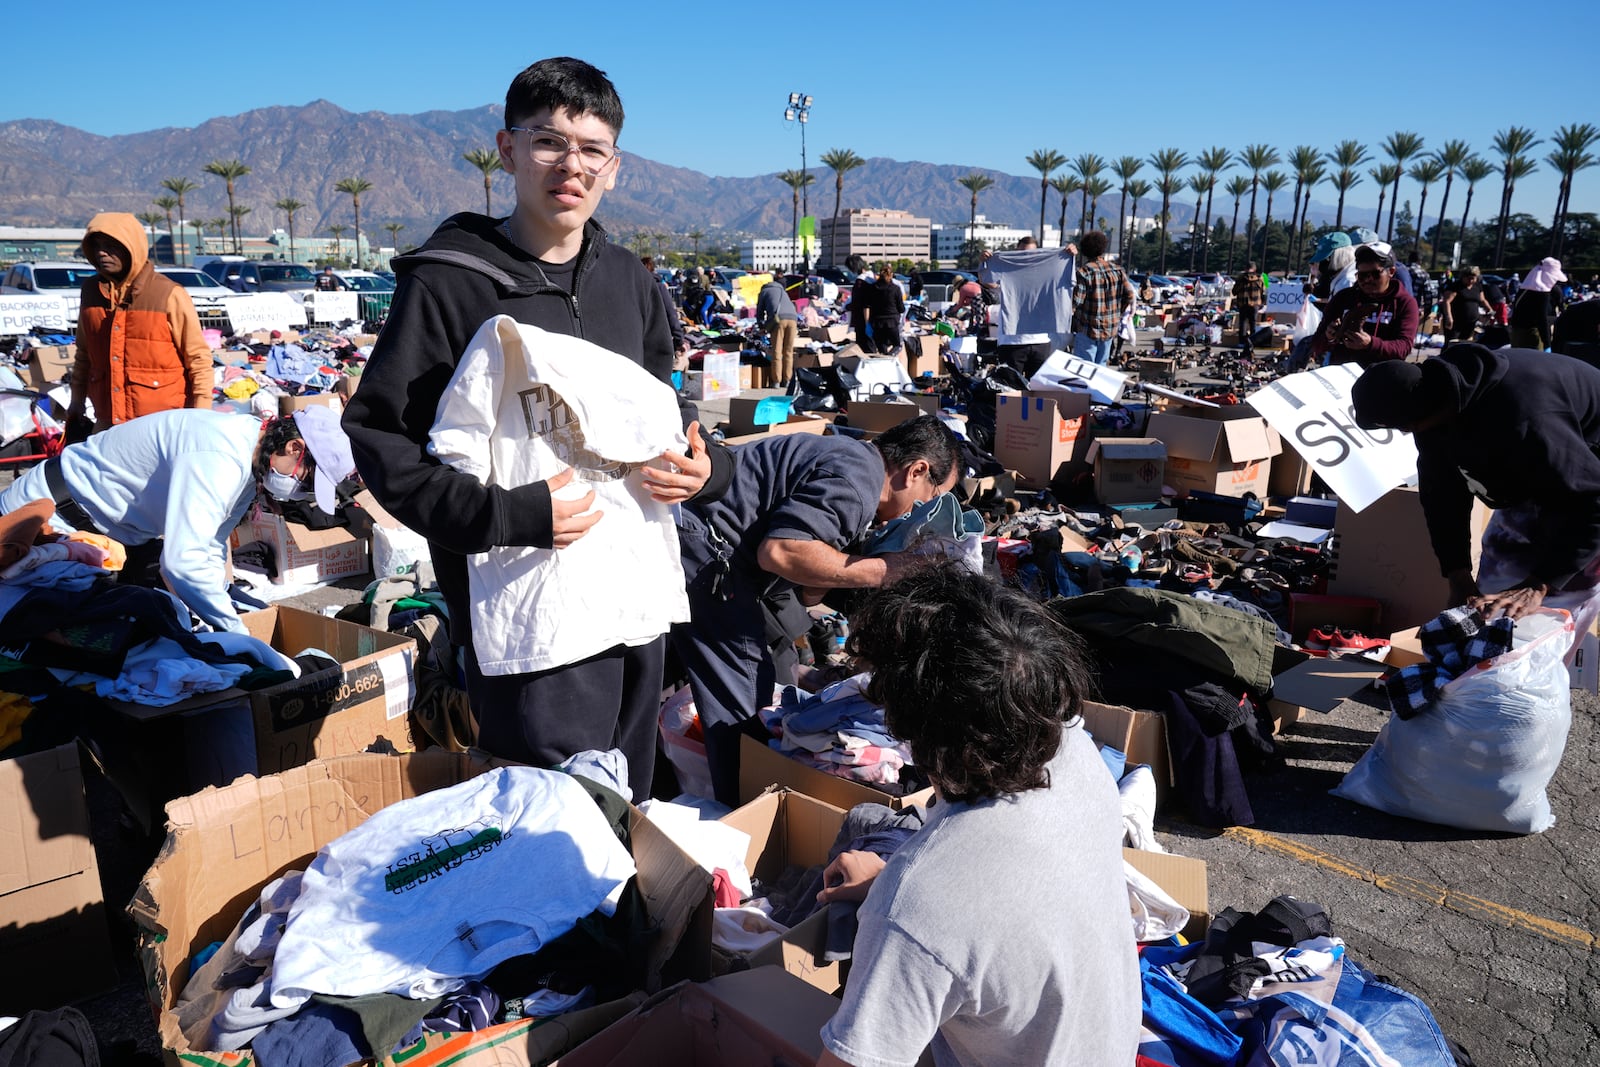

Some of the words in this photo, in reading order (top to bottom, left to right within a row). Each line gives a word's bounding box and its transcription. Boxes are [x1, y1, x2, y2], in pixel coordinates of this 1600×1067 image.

[0, 301, 60, 311] BACKPACKS
[3, 315, 63, 328] PURSES
[326, 558, 358, 568] MANTENTE
[326, 564, 358, 575] FUERTE
